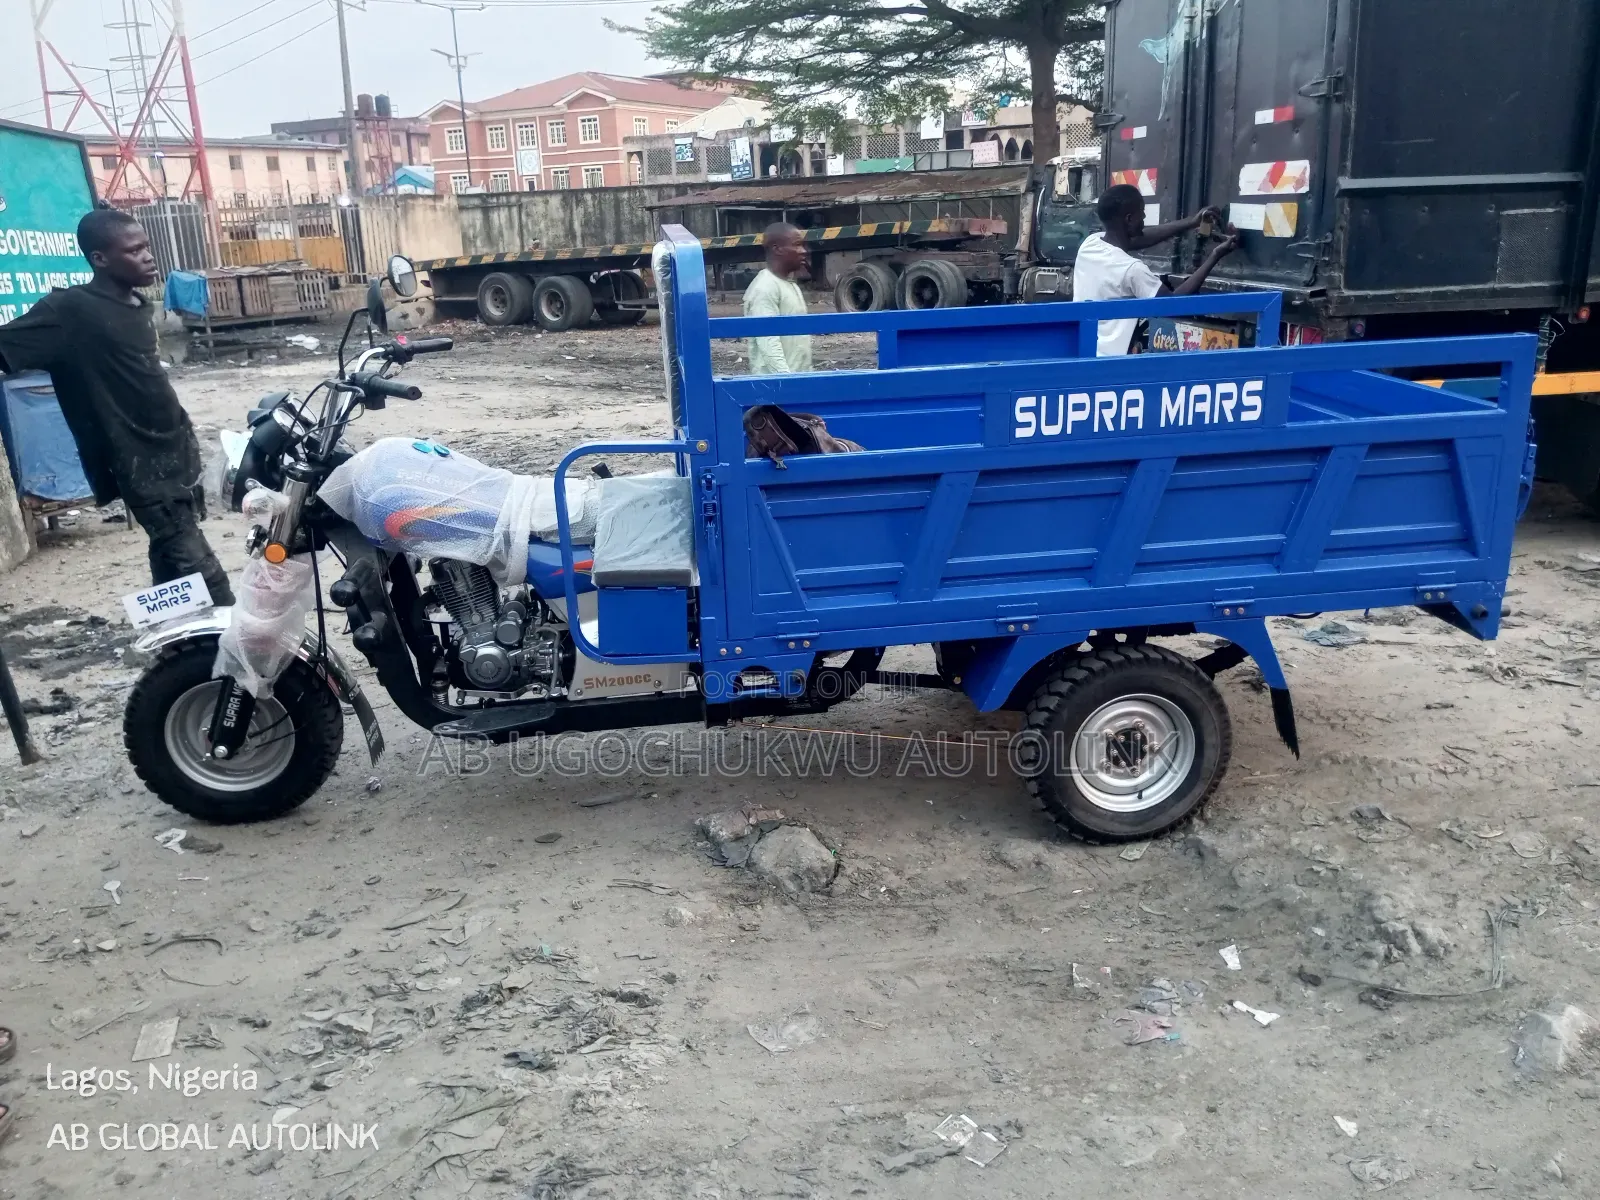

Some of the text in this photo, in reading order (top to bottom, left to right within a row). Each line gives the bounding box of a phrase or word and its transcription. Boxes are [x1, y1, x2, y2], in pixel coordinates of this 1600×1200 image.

[0, 228, 85, 257] GOVERNMEN
[15, 272, 37, 294] TO
[1014, 380, 1264, 438] SUPRA MARS
[136, 581, 192, 606] SUPRA
[146, 592, 191, 614] MARS
[583, 673, 652, 690] SM200CC
[223, 696, 241, 728] SUPRA
